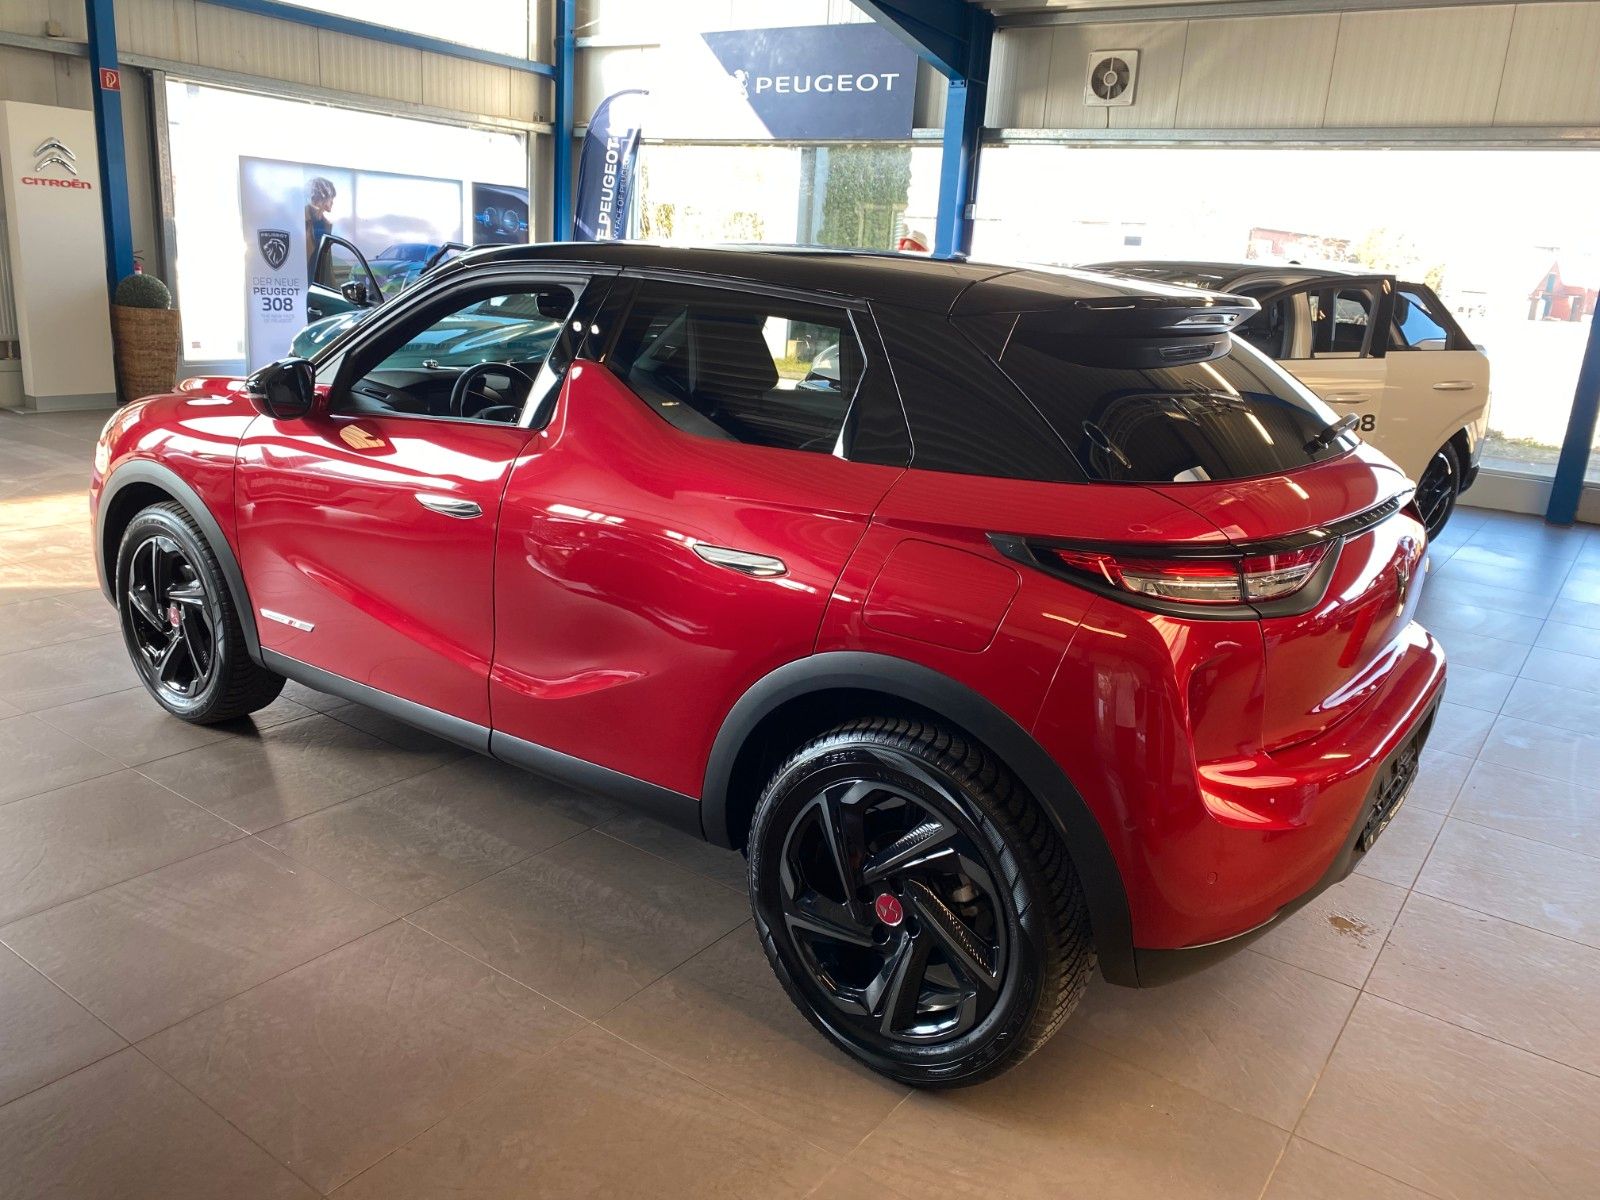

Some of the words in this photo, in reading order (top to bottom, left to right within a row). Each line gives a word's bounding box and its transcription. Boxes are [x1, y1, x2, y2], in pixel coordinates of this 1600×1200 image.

[755, 73, 900, 94] PEUGEOT
[21, 177, 92, 189] CITROËN
[252, 277, 273, 286] DER
[274, 278, 300, 287] NEUE
[253, 287, 300, 296] PEUGEOT
[262, 297, 293, 312] 308
